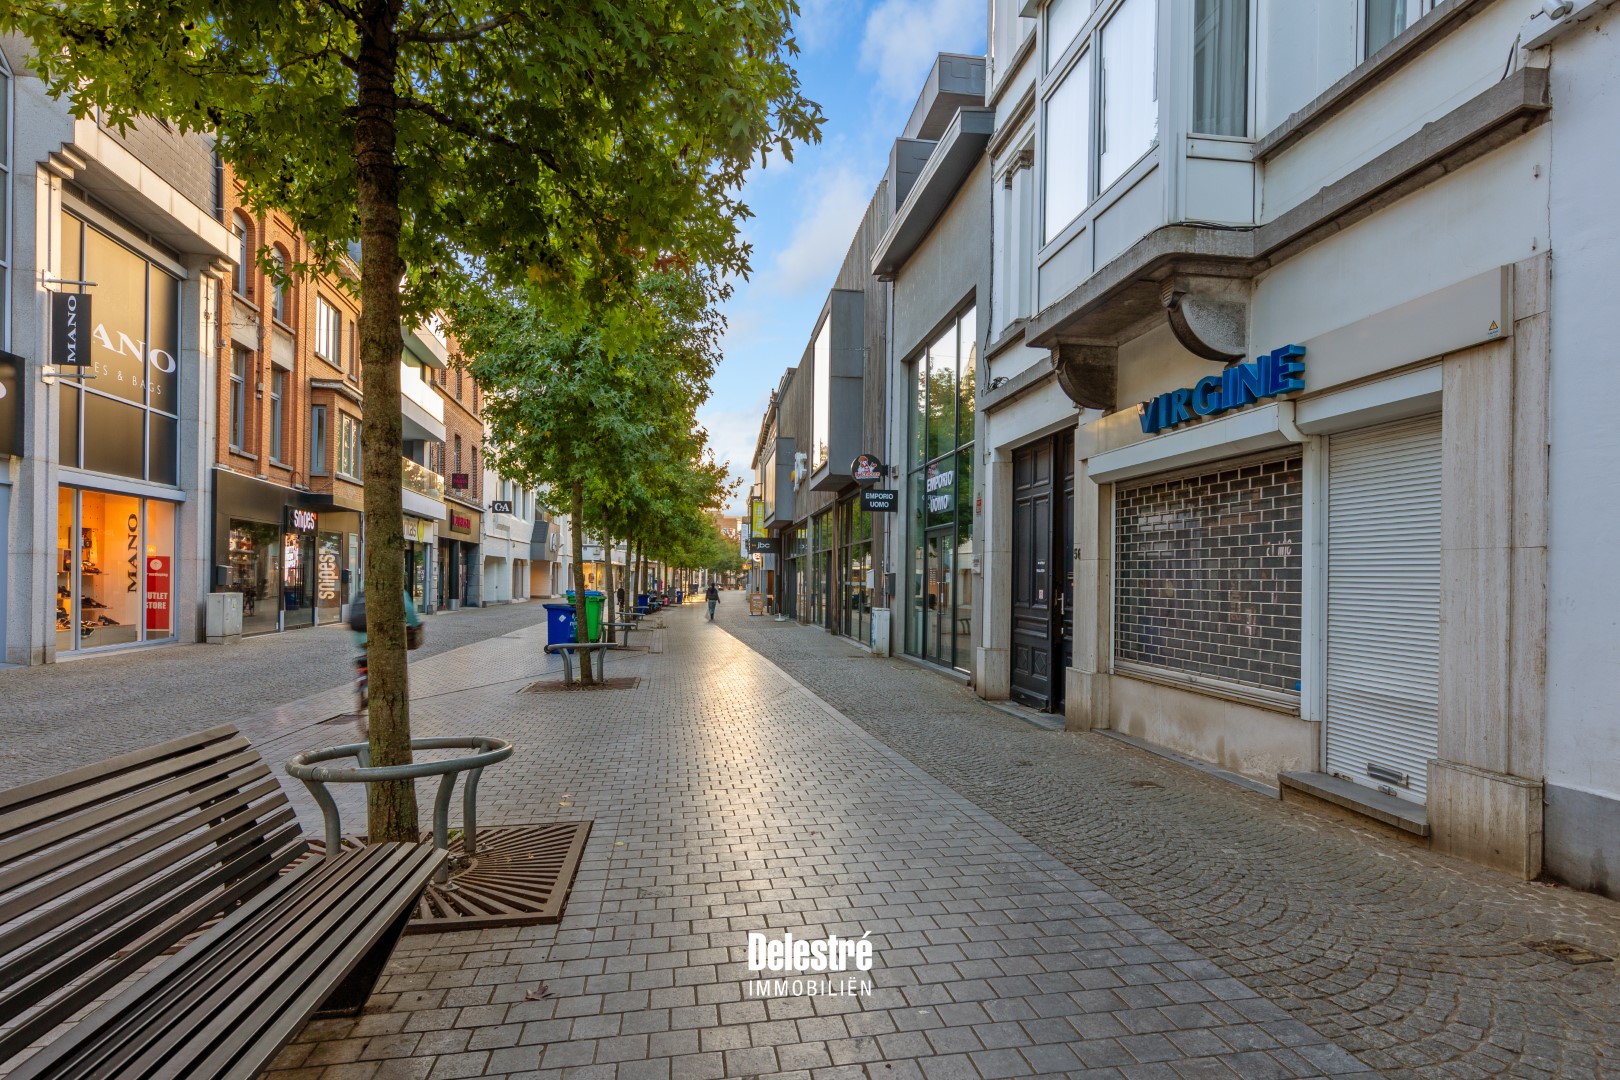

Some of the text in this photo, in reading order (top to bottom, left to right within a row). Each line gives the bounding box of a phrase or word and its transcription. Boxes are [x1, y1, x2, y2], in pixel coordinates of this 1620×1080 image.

[67, 295, 77, 363] MANO
[93, 323, 176, 374] ANO
[132, 375, 161, 395] BAGS
[1136, 344, 1306, 433] VIRGINE
[865, 492, 894, 500] EMPORIO
[927, 470, 954, 493] EMPORIO
[293, 509, 315, 532] snipes
[127, 513, 138, 593] MANO
[318, 554, 338, 600] snipes
[146, 591, 168, 600] UTLET
